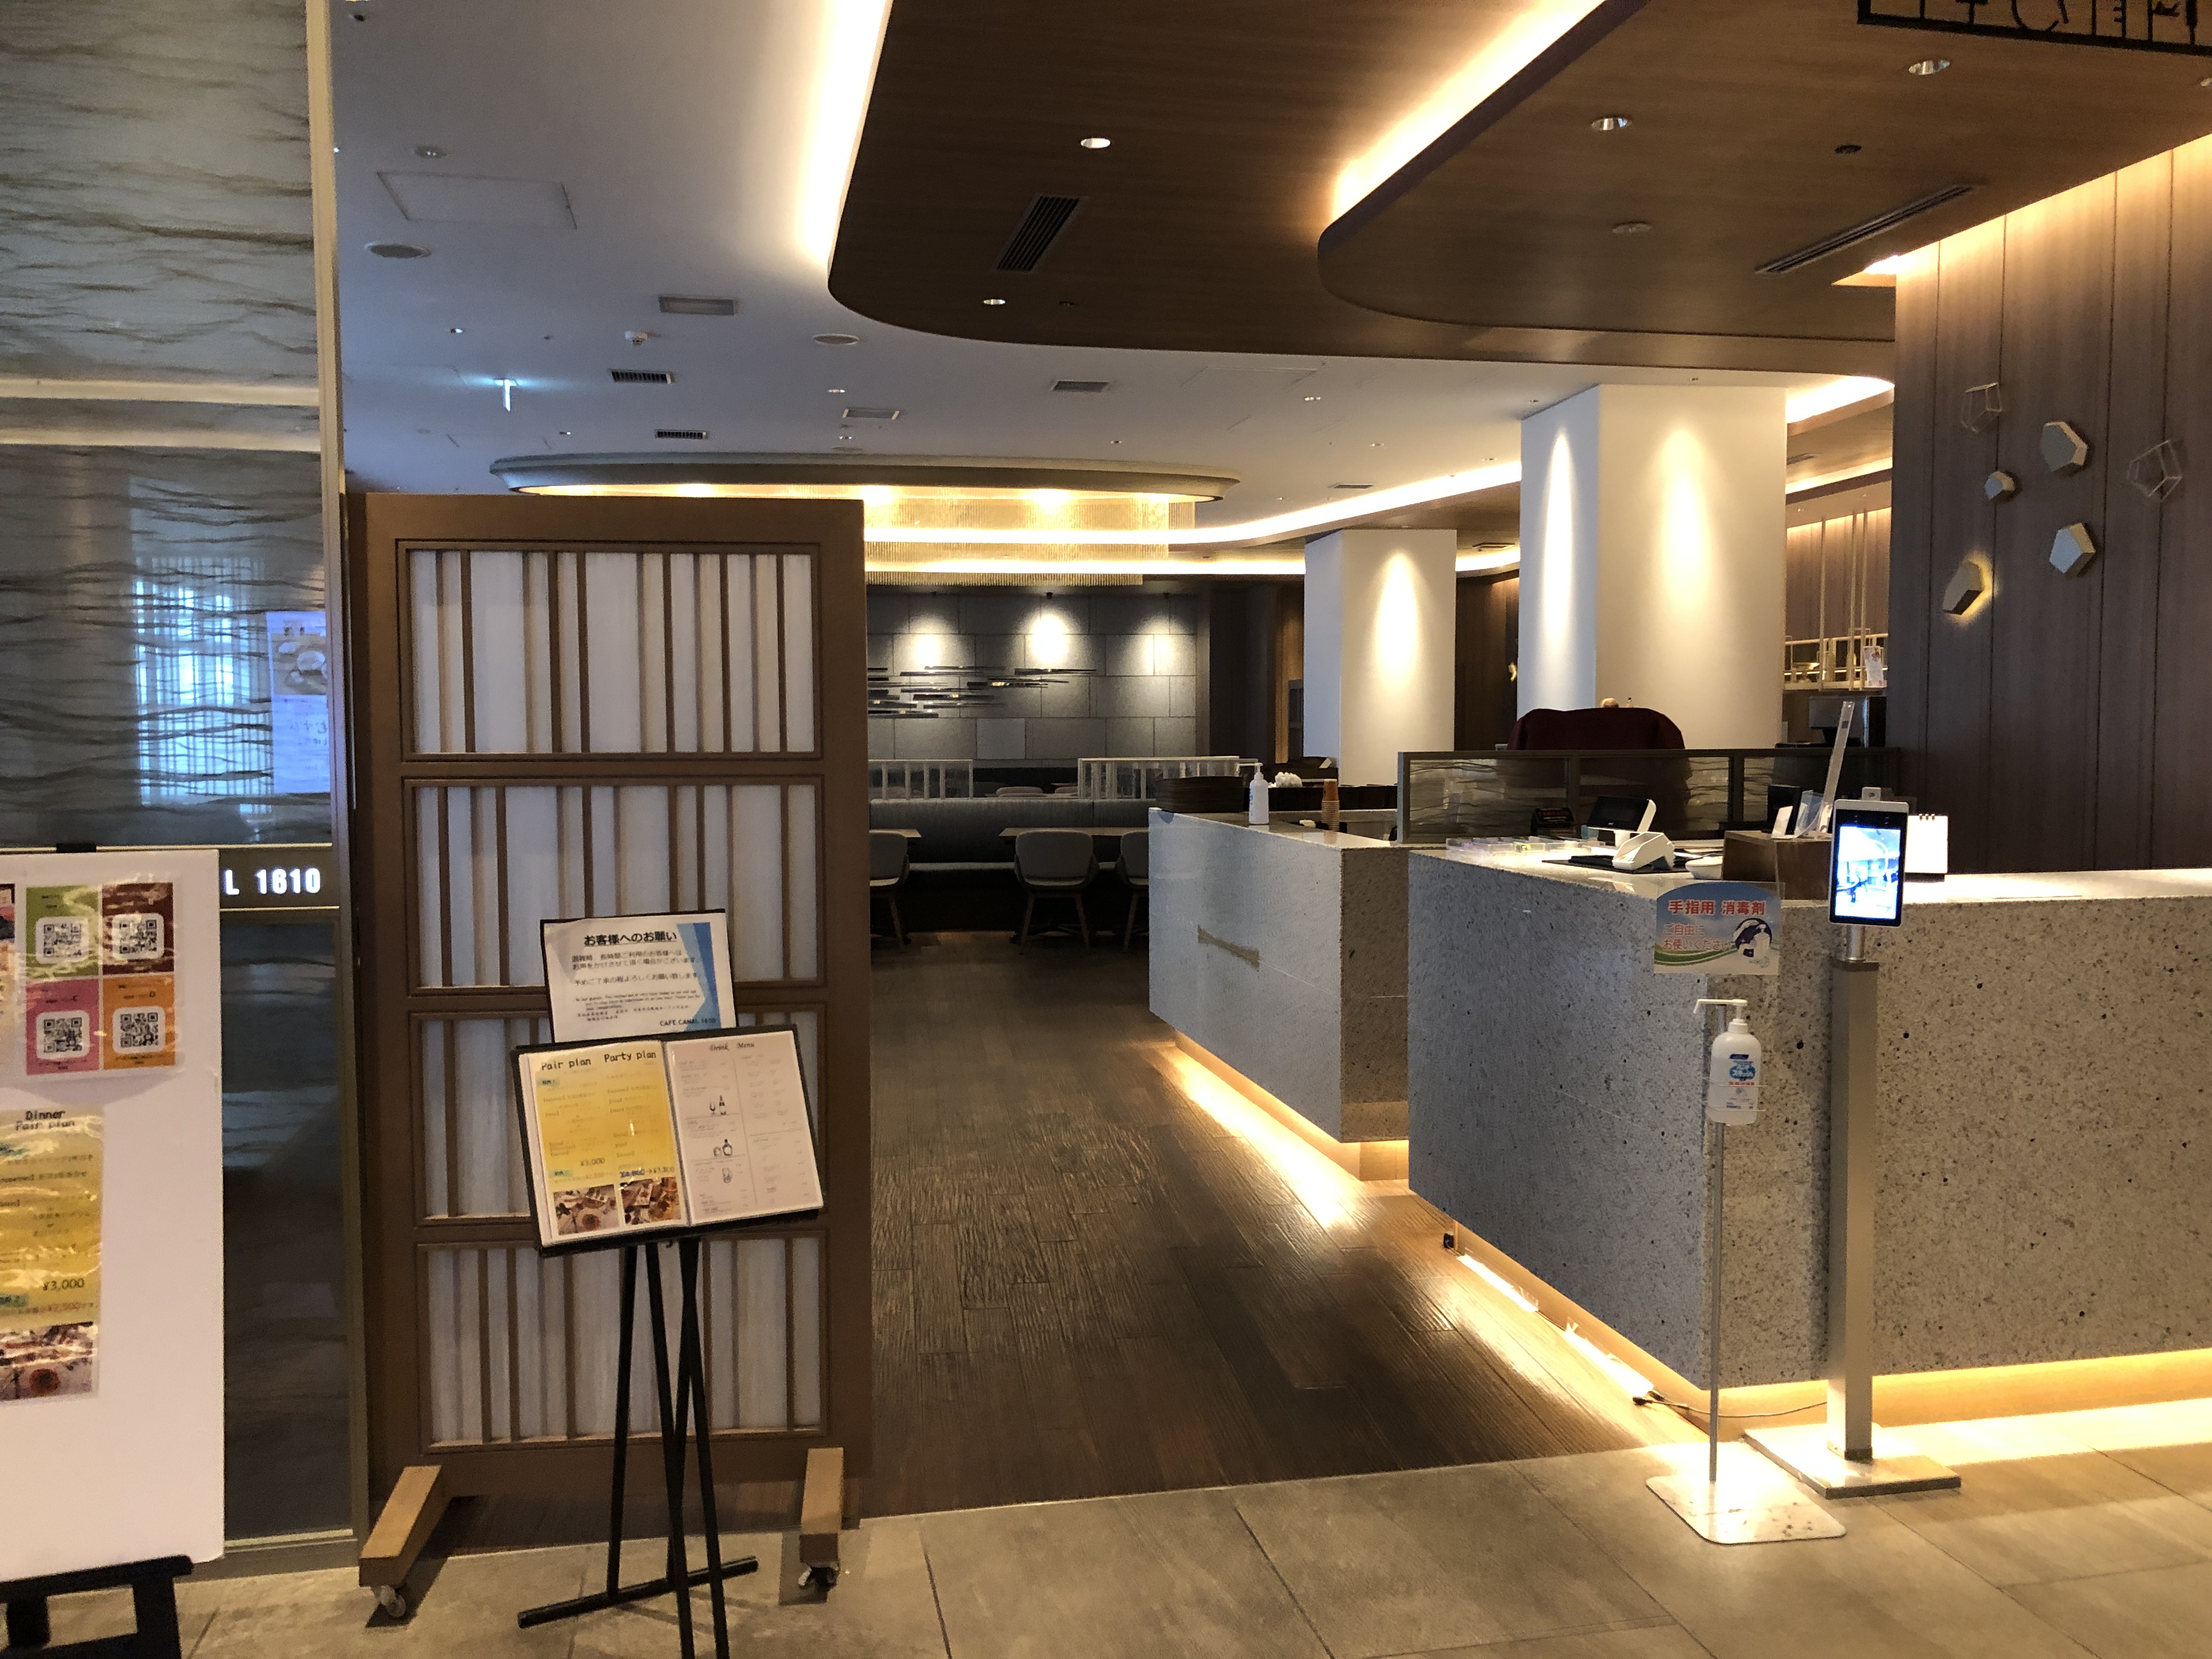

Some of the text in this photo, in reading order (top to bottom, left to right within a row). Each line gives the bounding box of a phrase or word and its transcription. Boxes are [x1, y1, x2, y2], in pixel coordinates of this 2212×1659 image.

[255, 868, 321, 894] 1610
[1668, 900, 1766, 915] 手指用 消毒剤
[1663, 923, 1704, 935] ご自由に
[584, 931, 677, 946] お客様へのお願い
[710, 1043, 729, 1051] Drink
[604, 1050, 657, 1063] Party plan
[541, 1058, 592, 1071] Pair plan
[25, 1110, 66, 1121] Dinner
[43, 1278, 85, 1291] ¥3,000
